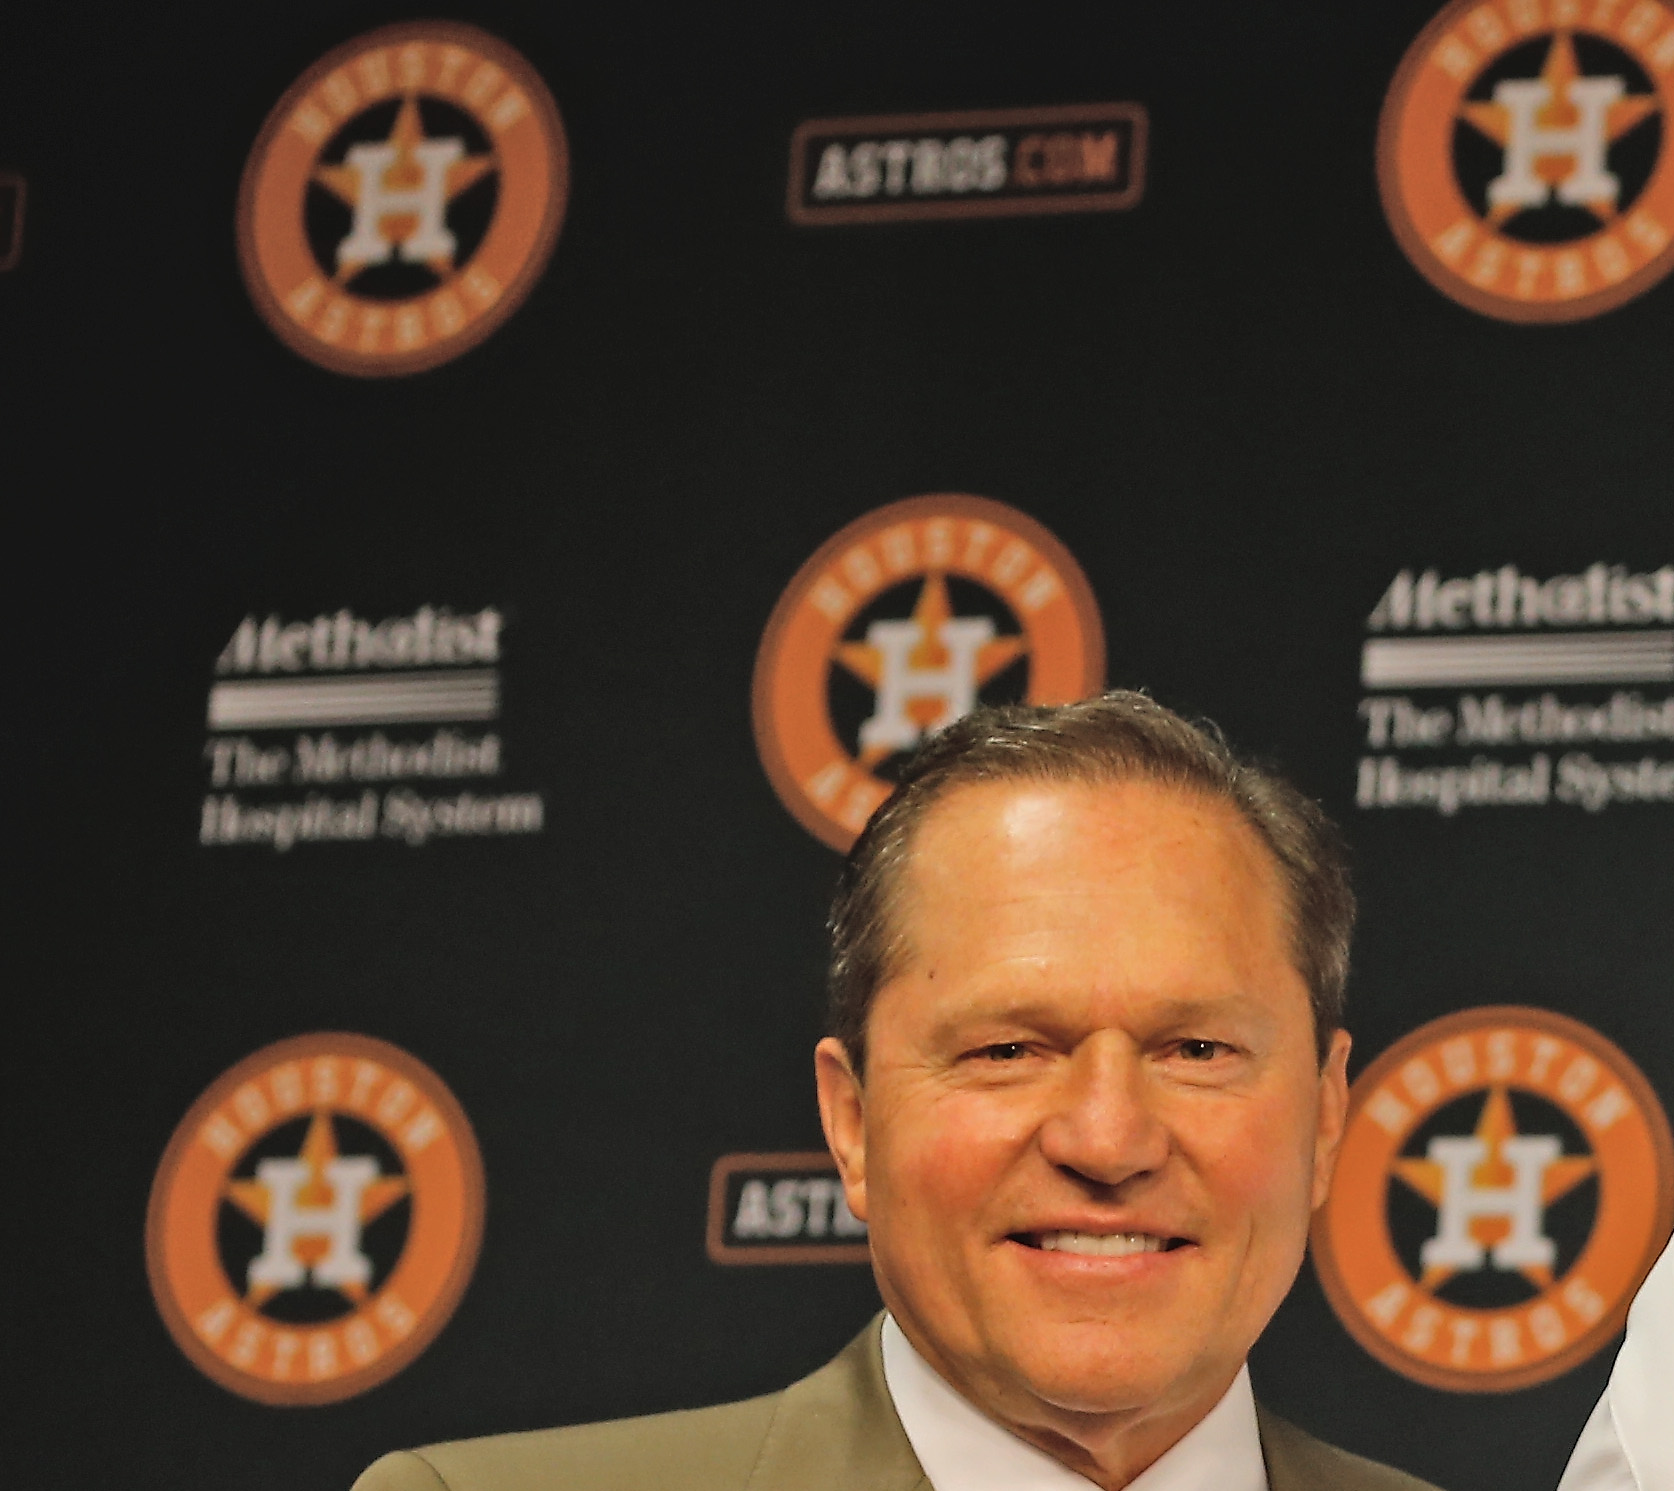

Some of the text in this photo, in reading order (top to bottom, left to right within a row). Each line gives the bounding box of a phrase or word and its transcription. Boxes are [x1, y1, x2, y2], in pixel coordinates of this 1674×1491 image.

[293, 43, 530, 142] HOUSTON
[1487, 75, 1629, 208] H
[336, 135, 465, 266] H
[1432, 212, 1670, 298] ASTROS
[288, 268, 500, 353] ASTROS
[812, 517, 1060, 622] HOUSTON
[213, 602, 506, 677] Methodist
[859, 616, 996, 749] H
[204, 734, 291, 788] The
[1359, 694, 1453, 749] The
[1355, 752, 1551, 817] Hospital
[202, 1055, 447, 1160] HOUSTON
[1364, 1031, 1634, 1135] HOUSTON
[246, 1155, 380, 1289] H
[1420, 1134, 1563, 1270] H
[198, 1296, 416, 1383] ASTROS
[1366, 1280, 1605, 1367] ASTROS
